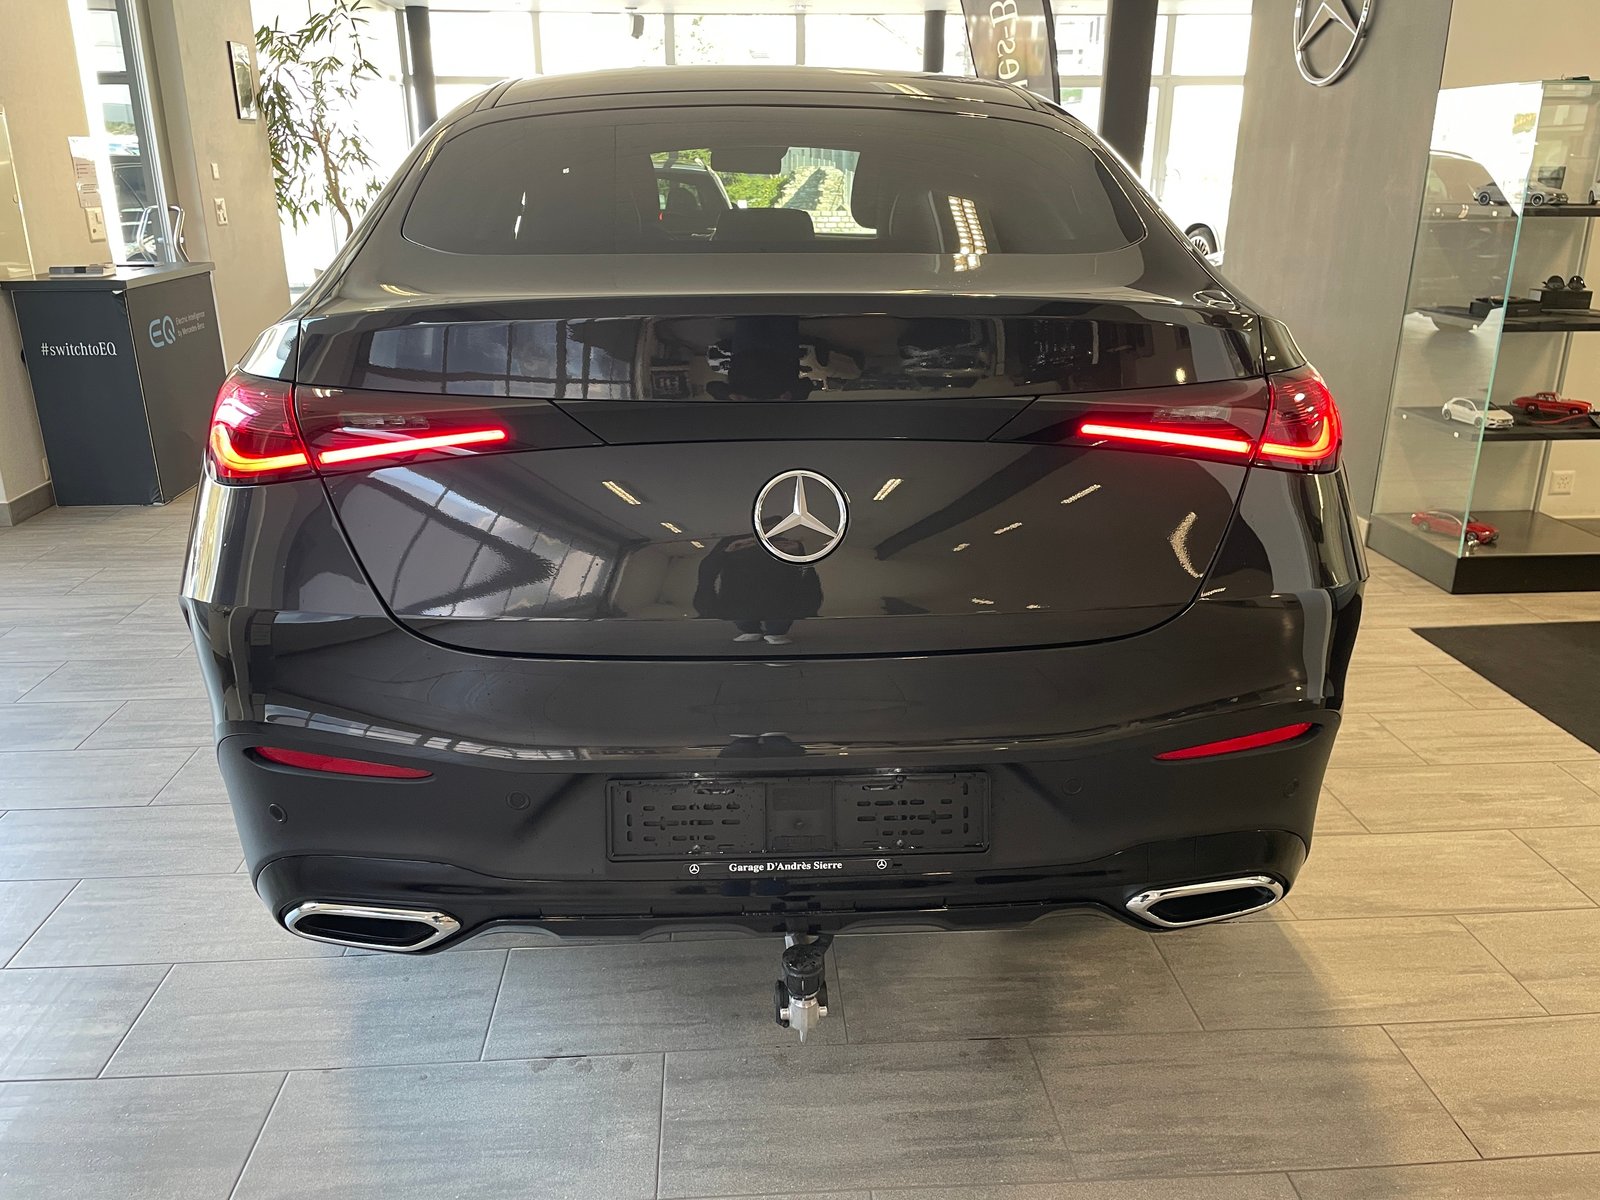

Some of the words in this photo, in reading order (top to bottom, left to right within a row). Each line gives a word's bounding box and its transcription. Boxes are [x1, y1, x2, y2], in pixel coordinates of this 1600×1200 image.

[149, 315, 176, 347] EQ
[40, 341, 118, 356] #switchtoEQ
[728, 863, 764, 873] Garage
[813, 861, 842, 870] Sierre
